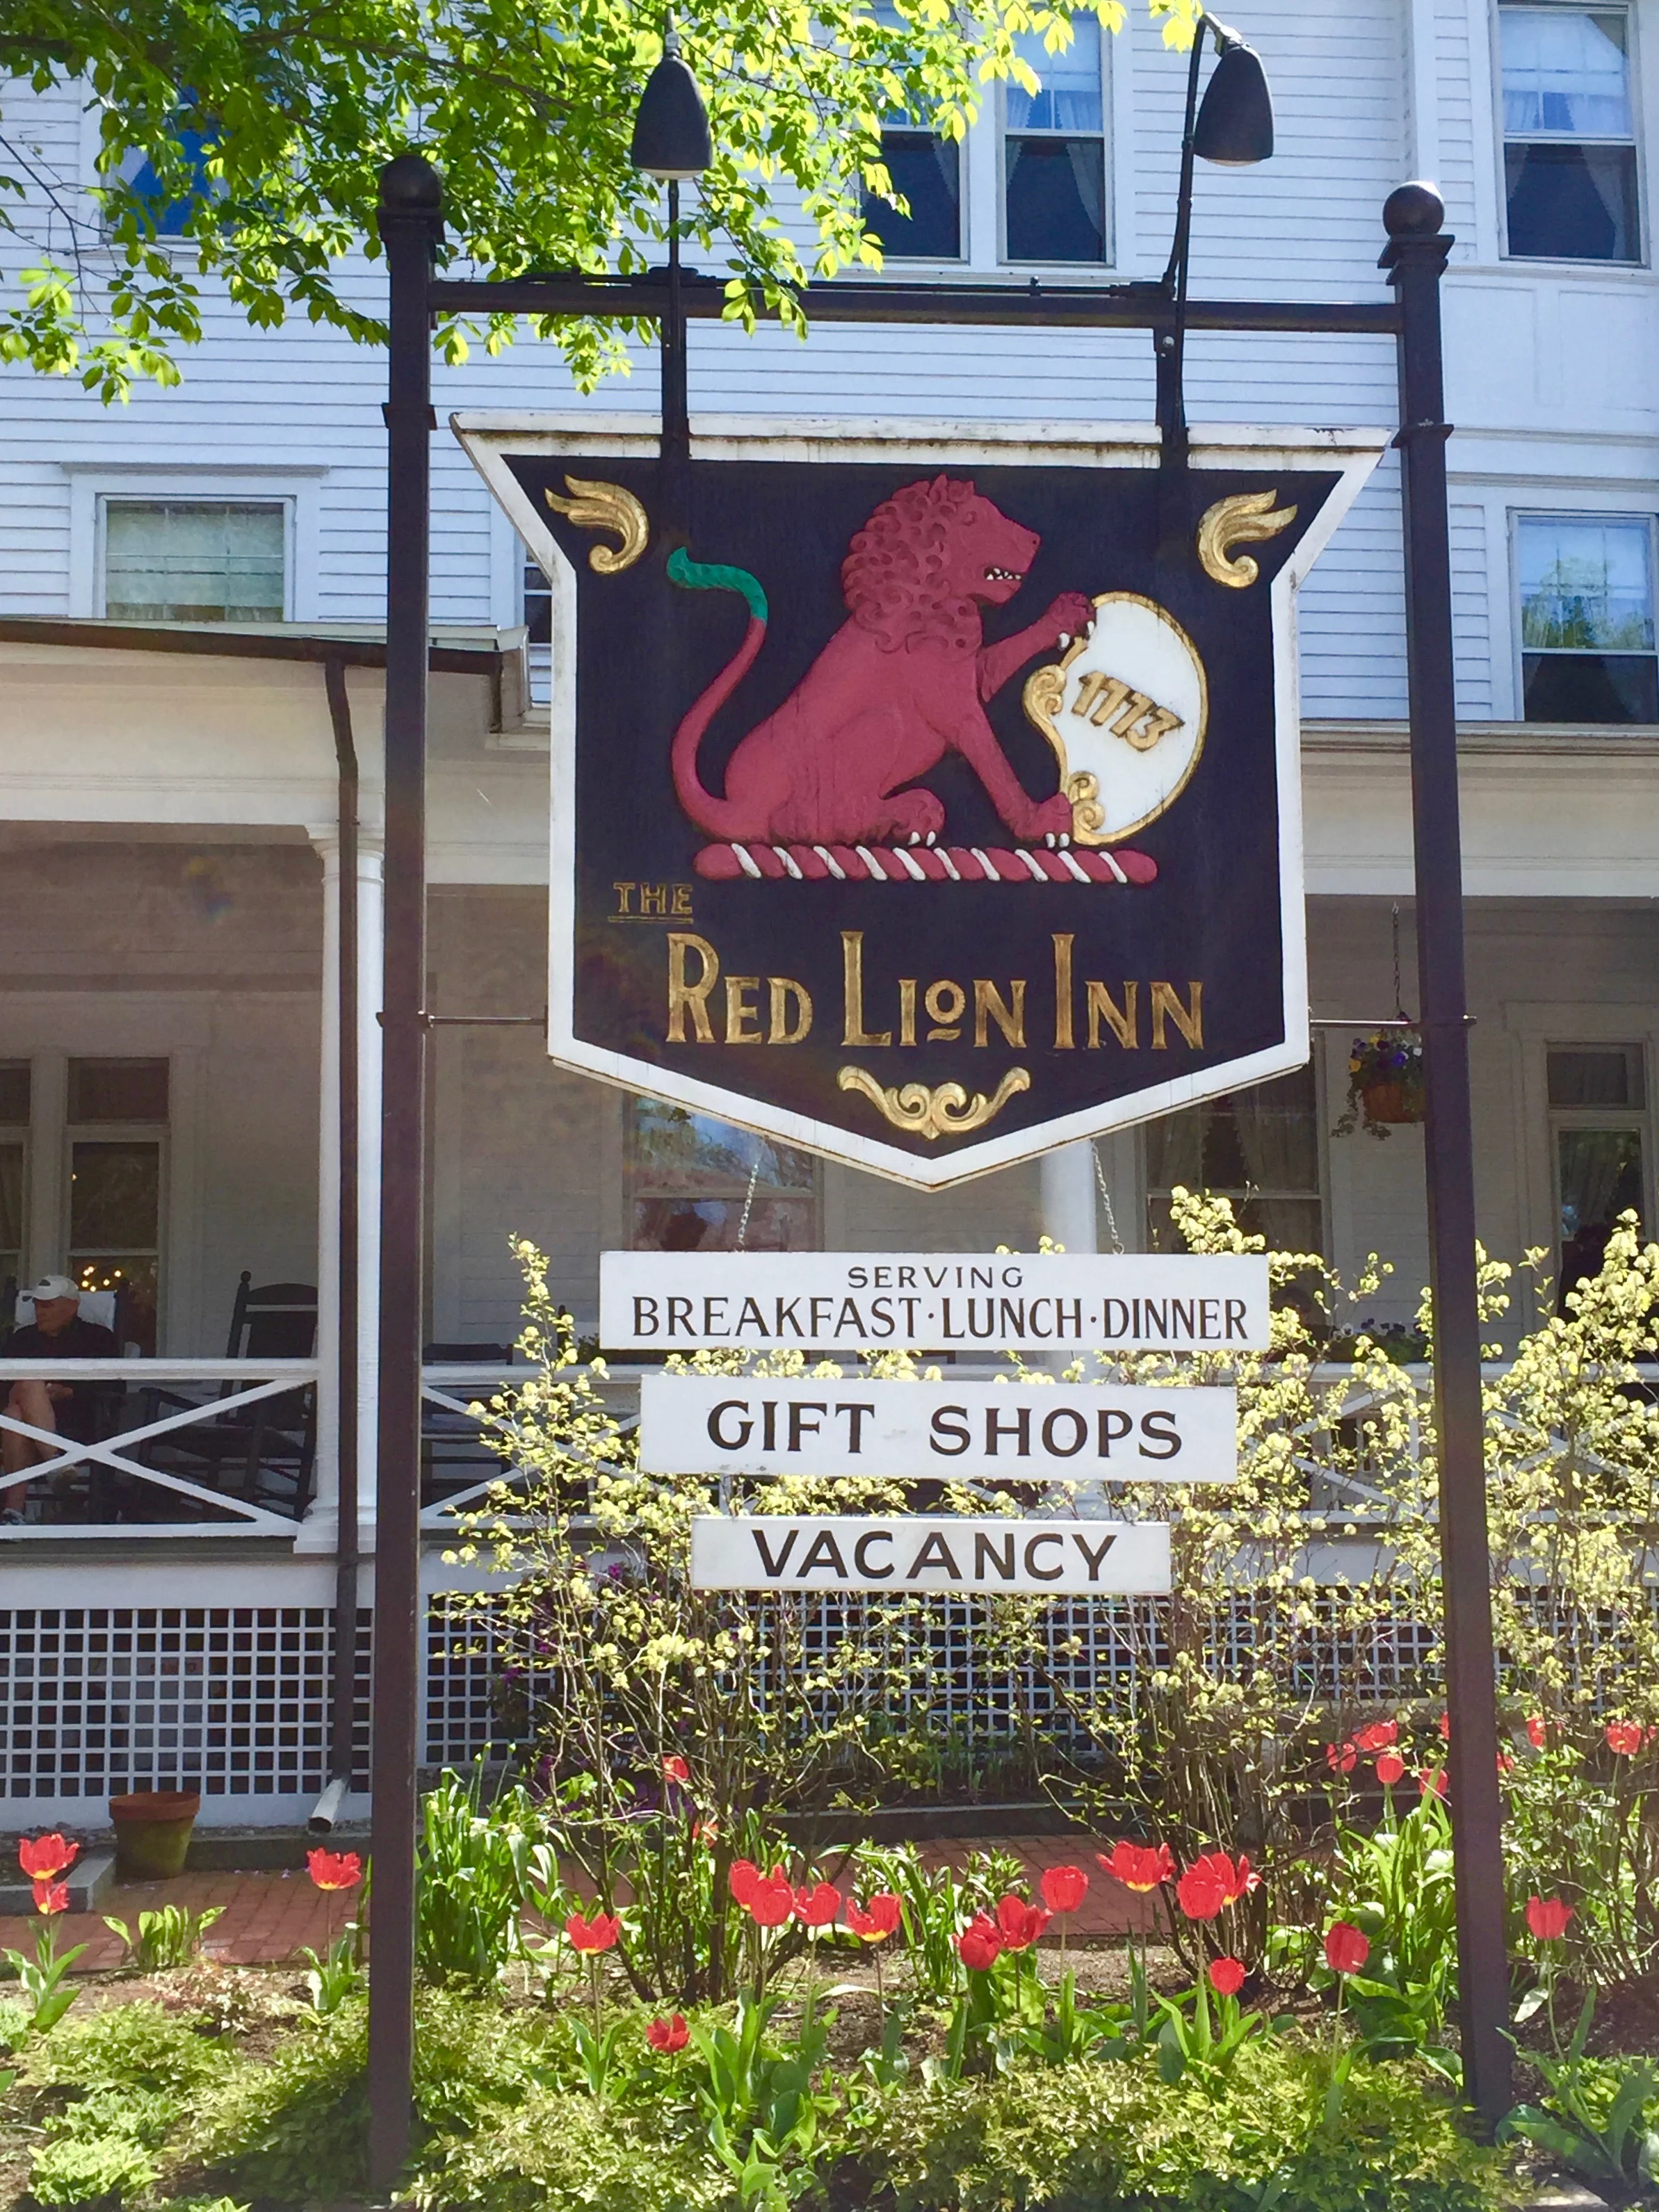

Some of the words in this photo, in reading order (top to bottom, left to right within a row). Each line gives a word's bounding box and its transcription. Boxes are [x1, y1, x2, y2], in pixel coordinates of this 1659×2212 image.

[1071, 671, 1185, 752] 1773
[613, 883, 693, 914] THE
[665, 932, 813, 1044] RED
[841, 931, 1028, 1048] LION
[1052, 934, 1204, 1050] INN
[848, 1266, 1023, 1289] SERVING
[707, 1400, 875, 1454] GIFT
[930, 1405, 1183, 1460] SHOPS
[752, 1529, 1117, 1581] VACANCY
